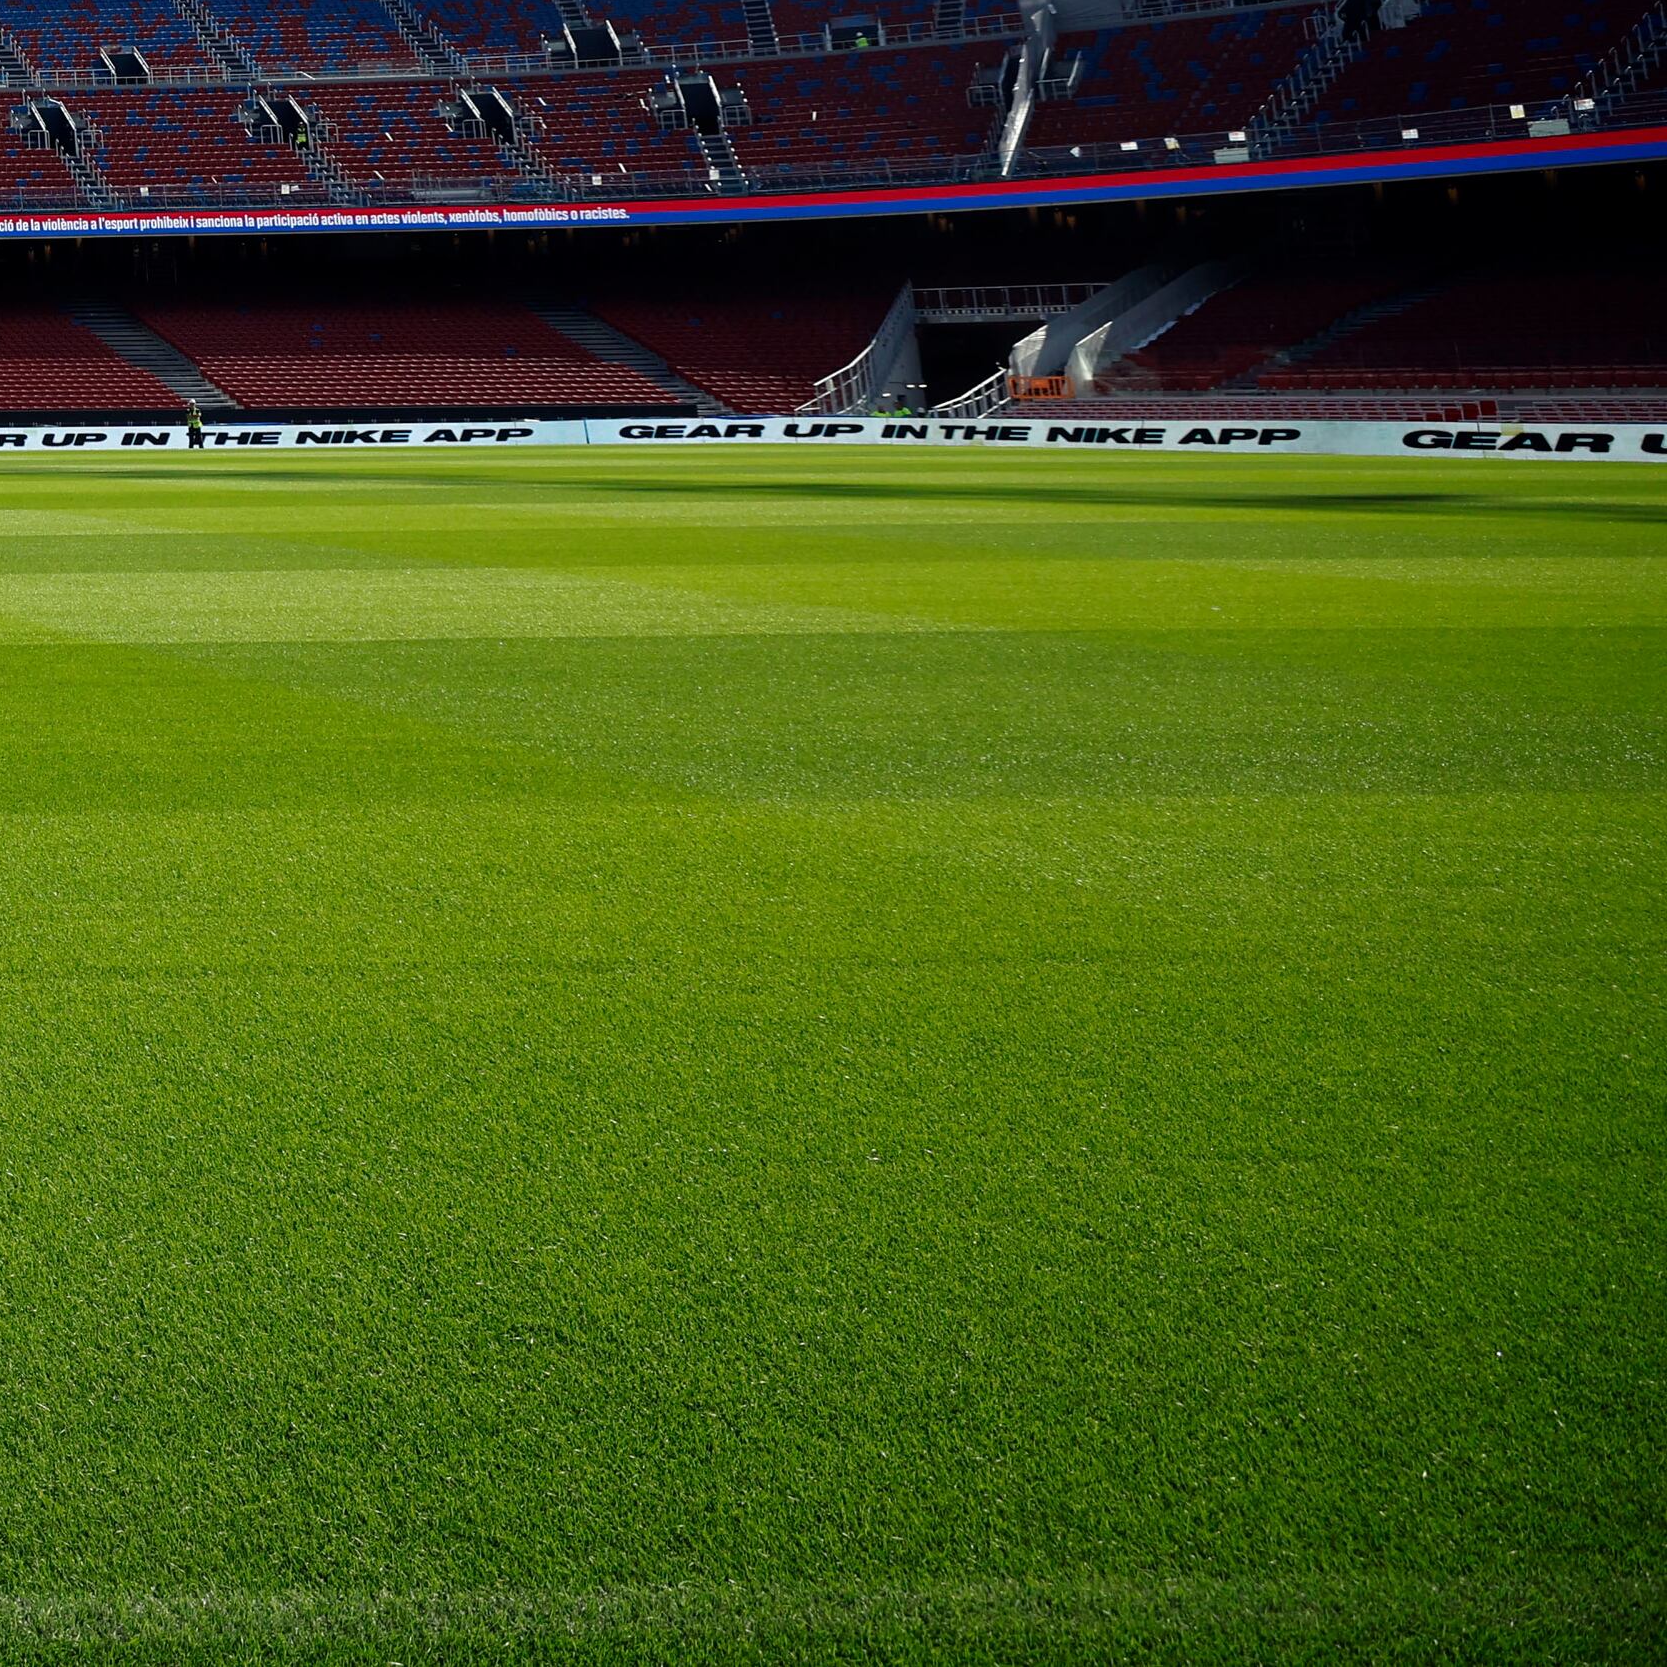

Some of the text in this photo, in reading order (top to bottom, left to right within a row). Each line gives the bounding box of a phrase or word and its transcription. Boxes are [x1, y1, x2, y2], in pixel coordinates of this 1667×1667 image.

[16, 218, 29, 232] de
[30, 218, 40, 231] la
[41, 217, 89, 231] violència
[90, 220, 98, 230] a
[98, 217, 139, 232] l'esport
[139, 216, 189, 231] prohibeix
[195, 215, 244, 228] sanciona
[244, 214, 255, 227] la
[256, 213, 319, 229] participació
[320, 212, 354, 226] activa
[354, 214, 369, 225] en
[370, 212, 401, 225] actes
[401, 210, 448, 225] violents,
[448, 209, 503, 224] xenòfobs,
[503, 208, 569, 222] homofòbics
[570, 210, 579, 221] o
[579, 206, 630, 220] racistes.
[41, 432, 108, 447] UP
[120, 432, 171, 446] IN
[186, 431, 282, 446] THE
[295, 429, 412, 445] NIKE
[423, 428, 534, 443] APP
[619, 423, 1302, 446] GEAR UP IN THE NIKE APP
[1402, 429, 1615, 453] GEAR
